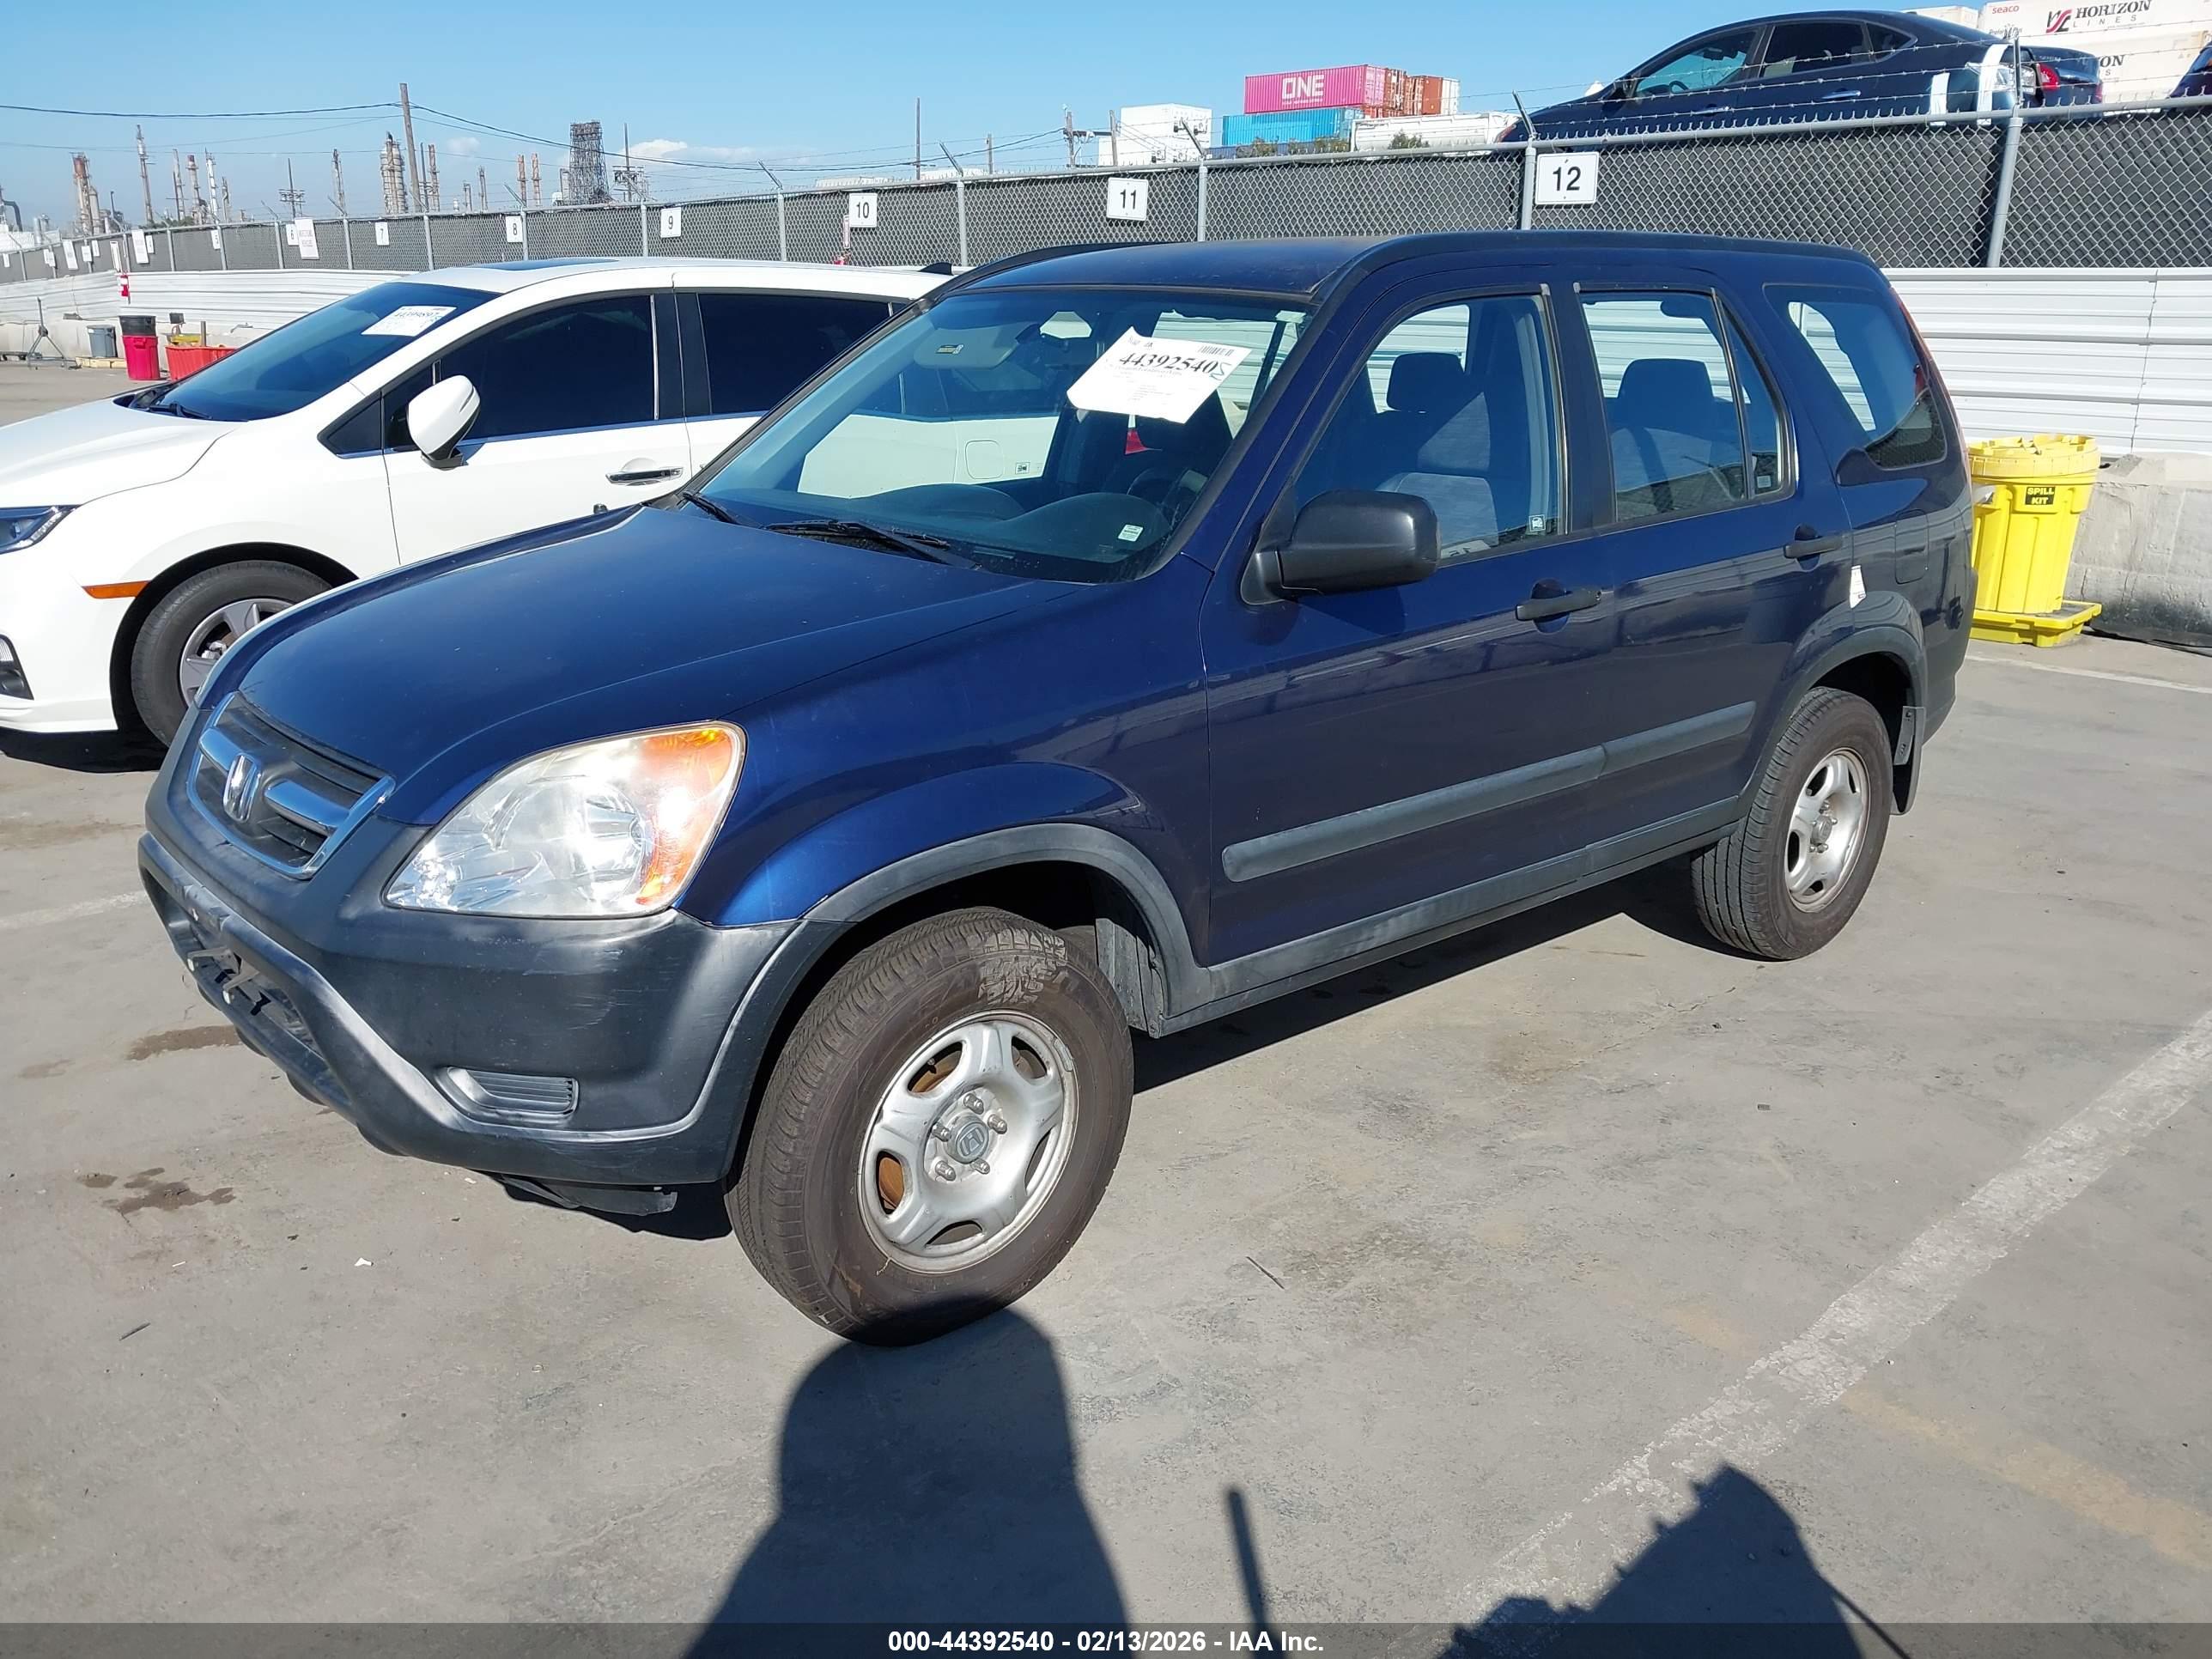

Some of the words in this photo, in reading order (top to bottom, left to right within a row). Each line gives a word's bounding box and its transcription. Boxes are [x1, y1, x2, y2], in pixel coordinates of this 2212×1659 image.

[1992, 5, 2020, 15] seaco
[2075, 0, 2152, 19] HORIZON
[2073, 14, 2137, 27] LINES
[1281, 74, 1325, 100] ONE
[1552, 166, 1582, 191] 12
[1120, 189, 1137, 210] 11
[856, 201, 870, 219] 10
[513, 222, 518, 235] 8
[668, 215, 674, 230] 9
[1119, 353, 1218, 374] 44392540
[2027, 487, 2055, 495] SPILL
[2032, 496, 2049, 505] KIT
